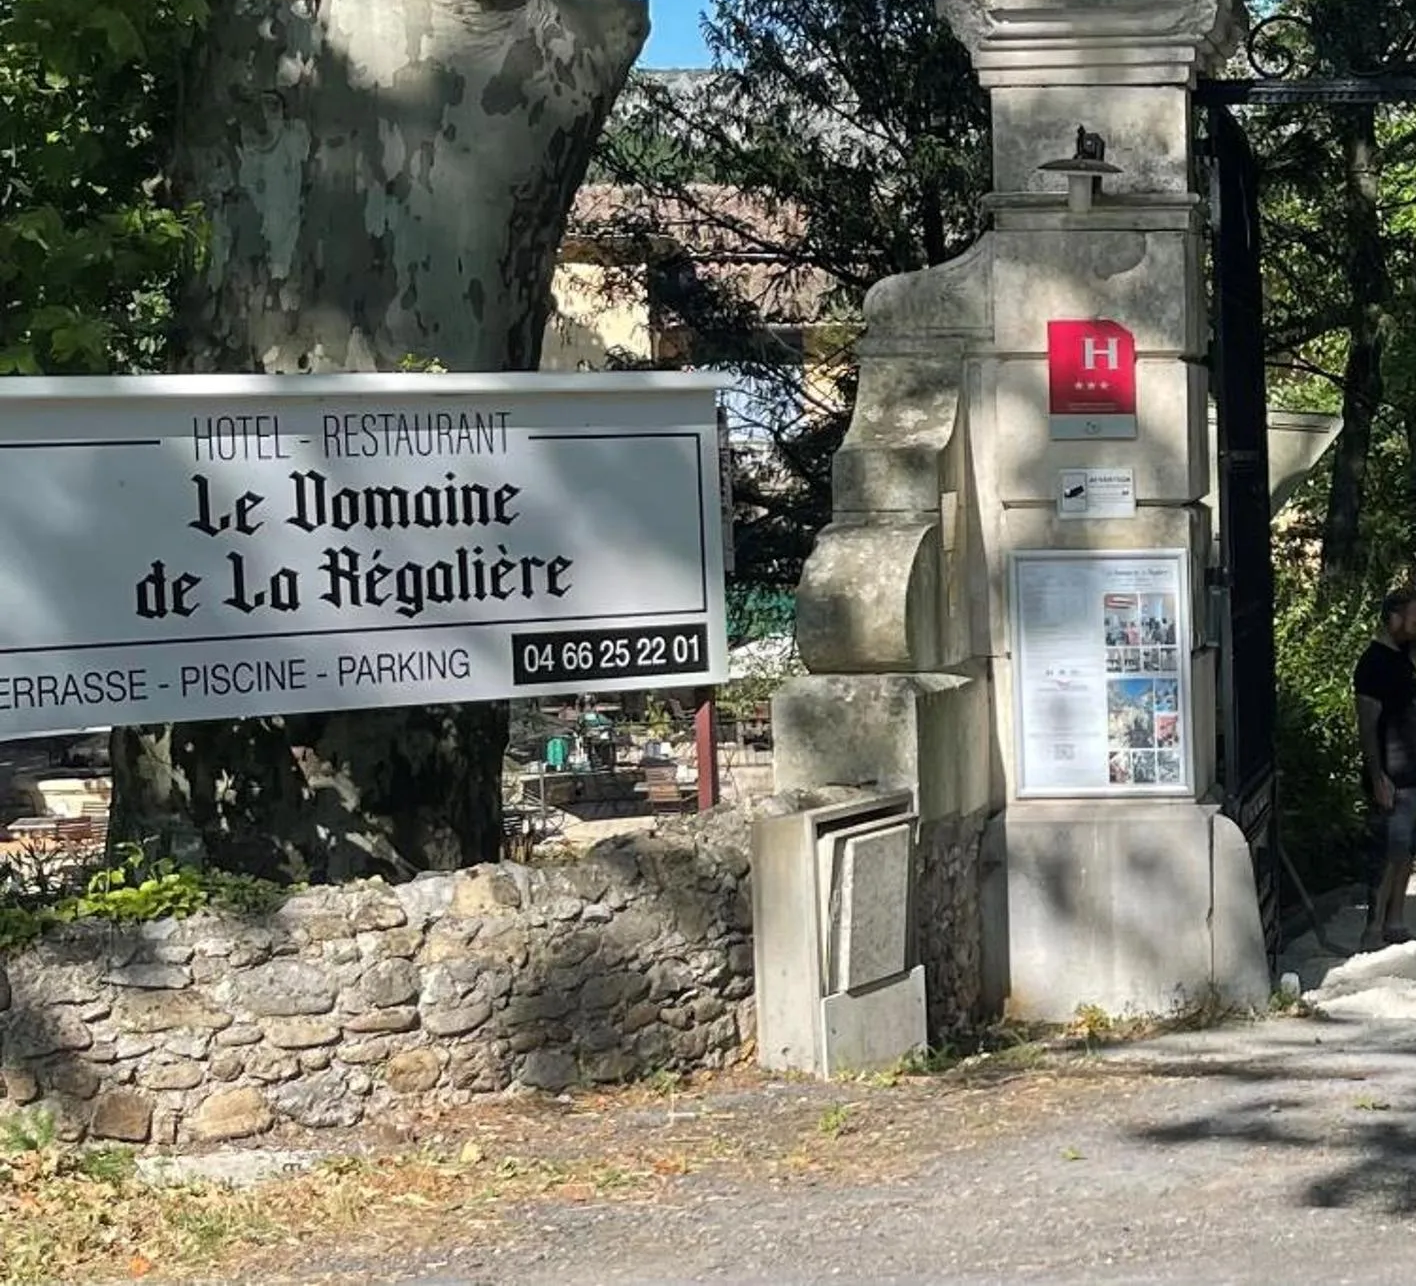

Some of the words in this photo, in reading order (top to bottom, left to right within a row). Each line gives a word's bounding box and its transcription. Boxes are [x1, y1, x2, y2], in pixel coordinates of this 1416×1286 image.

[1083, 337, 1119, 370] H
[193, 415, 291, 462] HOTEL
[323, 412, 512, 459] RESTAURANT
[188, 473, 265, 537] Le
[286, 469, 522, 533] Domaine
[136, 559, 202, 618] de
[222, 550, 301, 614] La
[318, 543, 574, 619] Régalière
[180, 658, 307, 698] PISCINE
[338, 648, 471, 687] PARKING
[524, 644, 555, 672] 04
[562, 641, 593, 671] 66
[600, 638, 630, 668] 25
[637, 636, 668, 667] 22
[673, 634, 700, 663] 01
